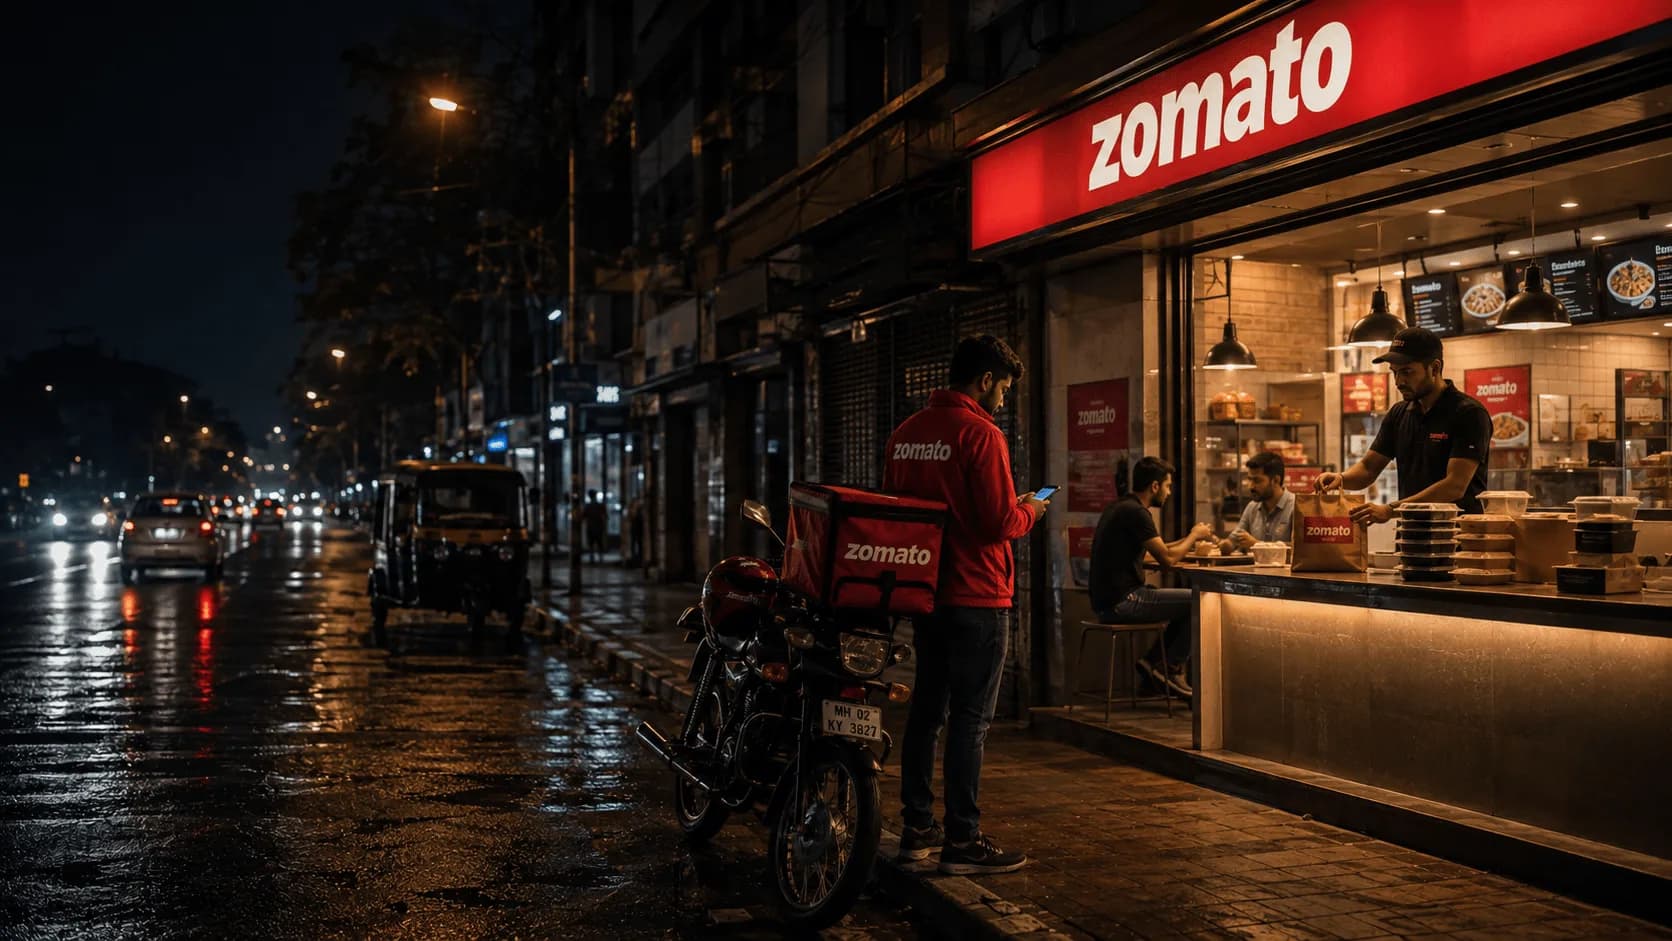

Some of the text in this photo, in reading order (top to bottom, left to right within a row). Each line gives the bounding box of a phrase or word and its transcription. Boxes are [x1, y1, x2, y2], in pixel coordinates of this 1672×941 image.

[1089, 20, 1352, 191] zomato
[1476, 381, 1518, 397] zomato
[1077, 405, 1116, 426] zomato
[893, 439, 951, 462] zomato
[1306, 525, 1351, 536] zomato
[845, 541, 931, 566] zomato
[834, 705, 870, 721] MH 02
[828, 719, 877, 737] KY 3827
